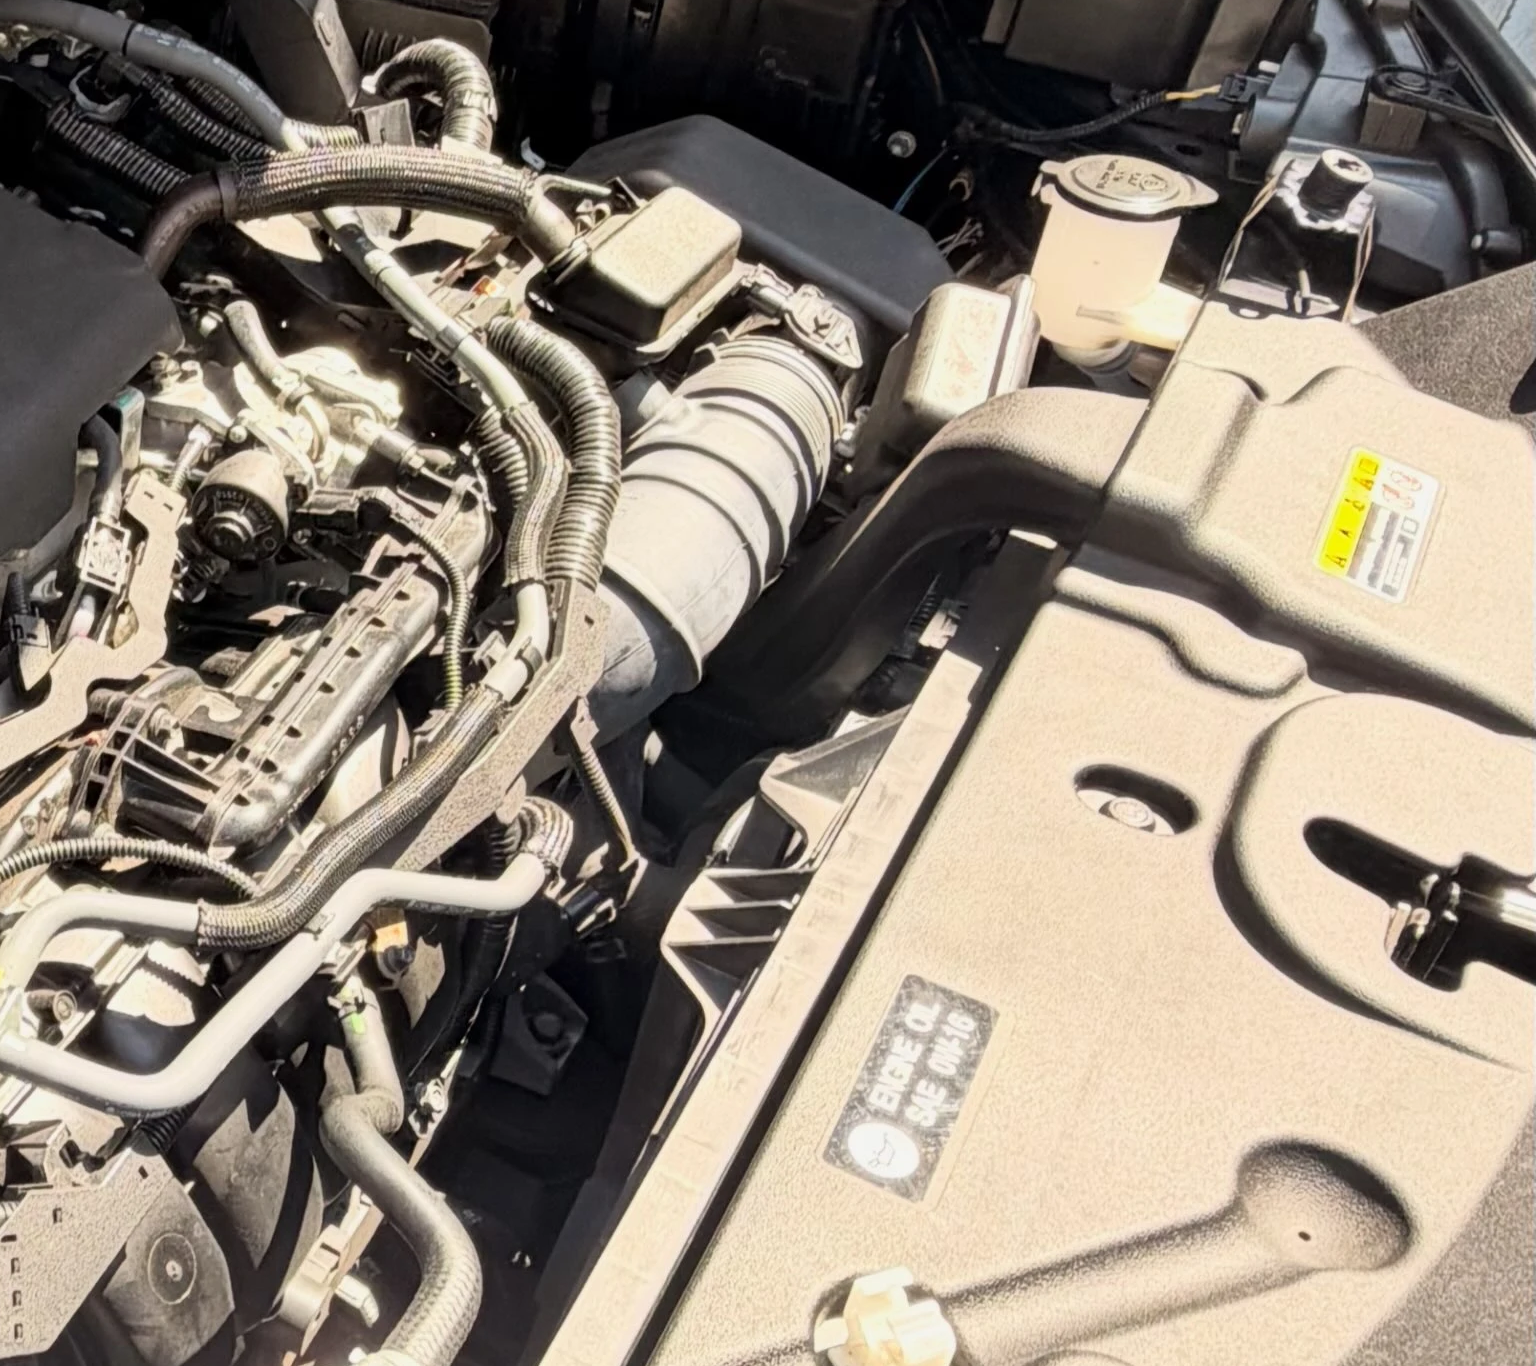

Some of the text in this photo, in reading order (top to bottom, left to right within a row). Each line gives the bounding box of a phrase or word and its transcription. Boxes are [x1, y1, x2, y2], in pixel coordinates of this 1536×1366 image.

[868, 1002, 941, 1113] ENGINE OIL
[905, 1011, 977, 1127] SAE 0W-16
